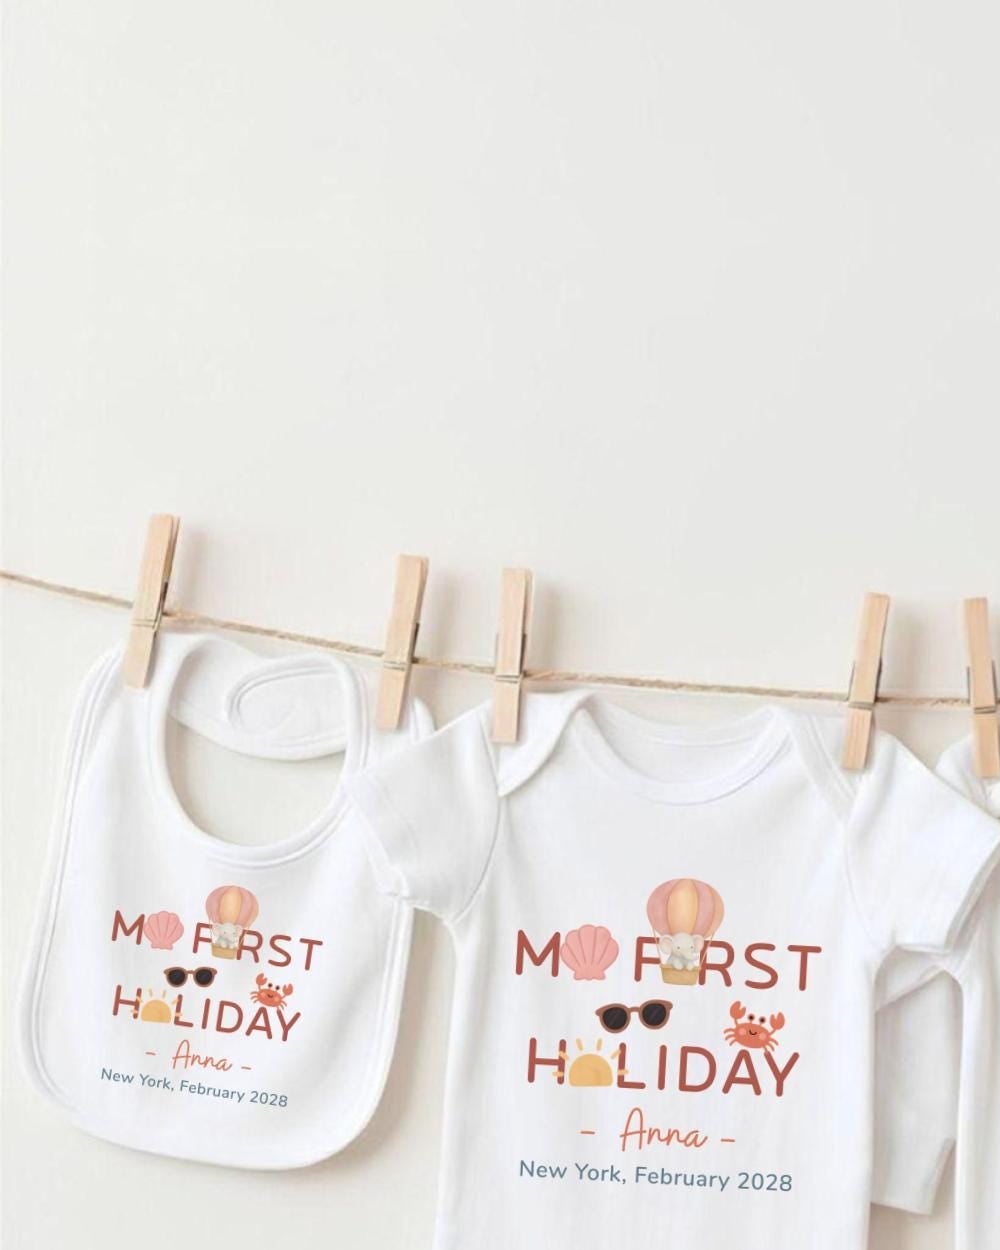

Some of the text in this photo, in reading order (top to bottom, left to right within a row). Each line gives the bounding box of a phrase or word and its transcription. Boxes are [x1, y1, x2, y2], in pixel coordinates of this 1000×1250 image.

[193, 923, 323, 970] FRST
[634, 936, 821, 991] FRST
[113, 985, 301, 1041] HLIDAY
[172, 1040, 232, 1071] Anna
[528, 1038, 799, 1097] HLIDAY
[101, 1068, 288, 1107] New York, February 2028
[620, 1107, 707, 1151] Anna
[519, 1160, 793, 1191] New York, February 2028
